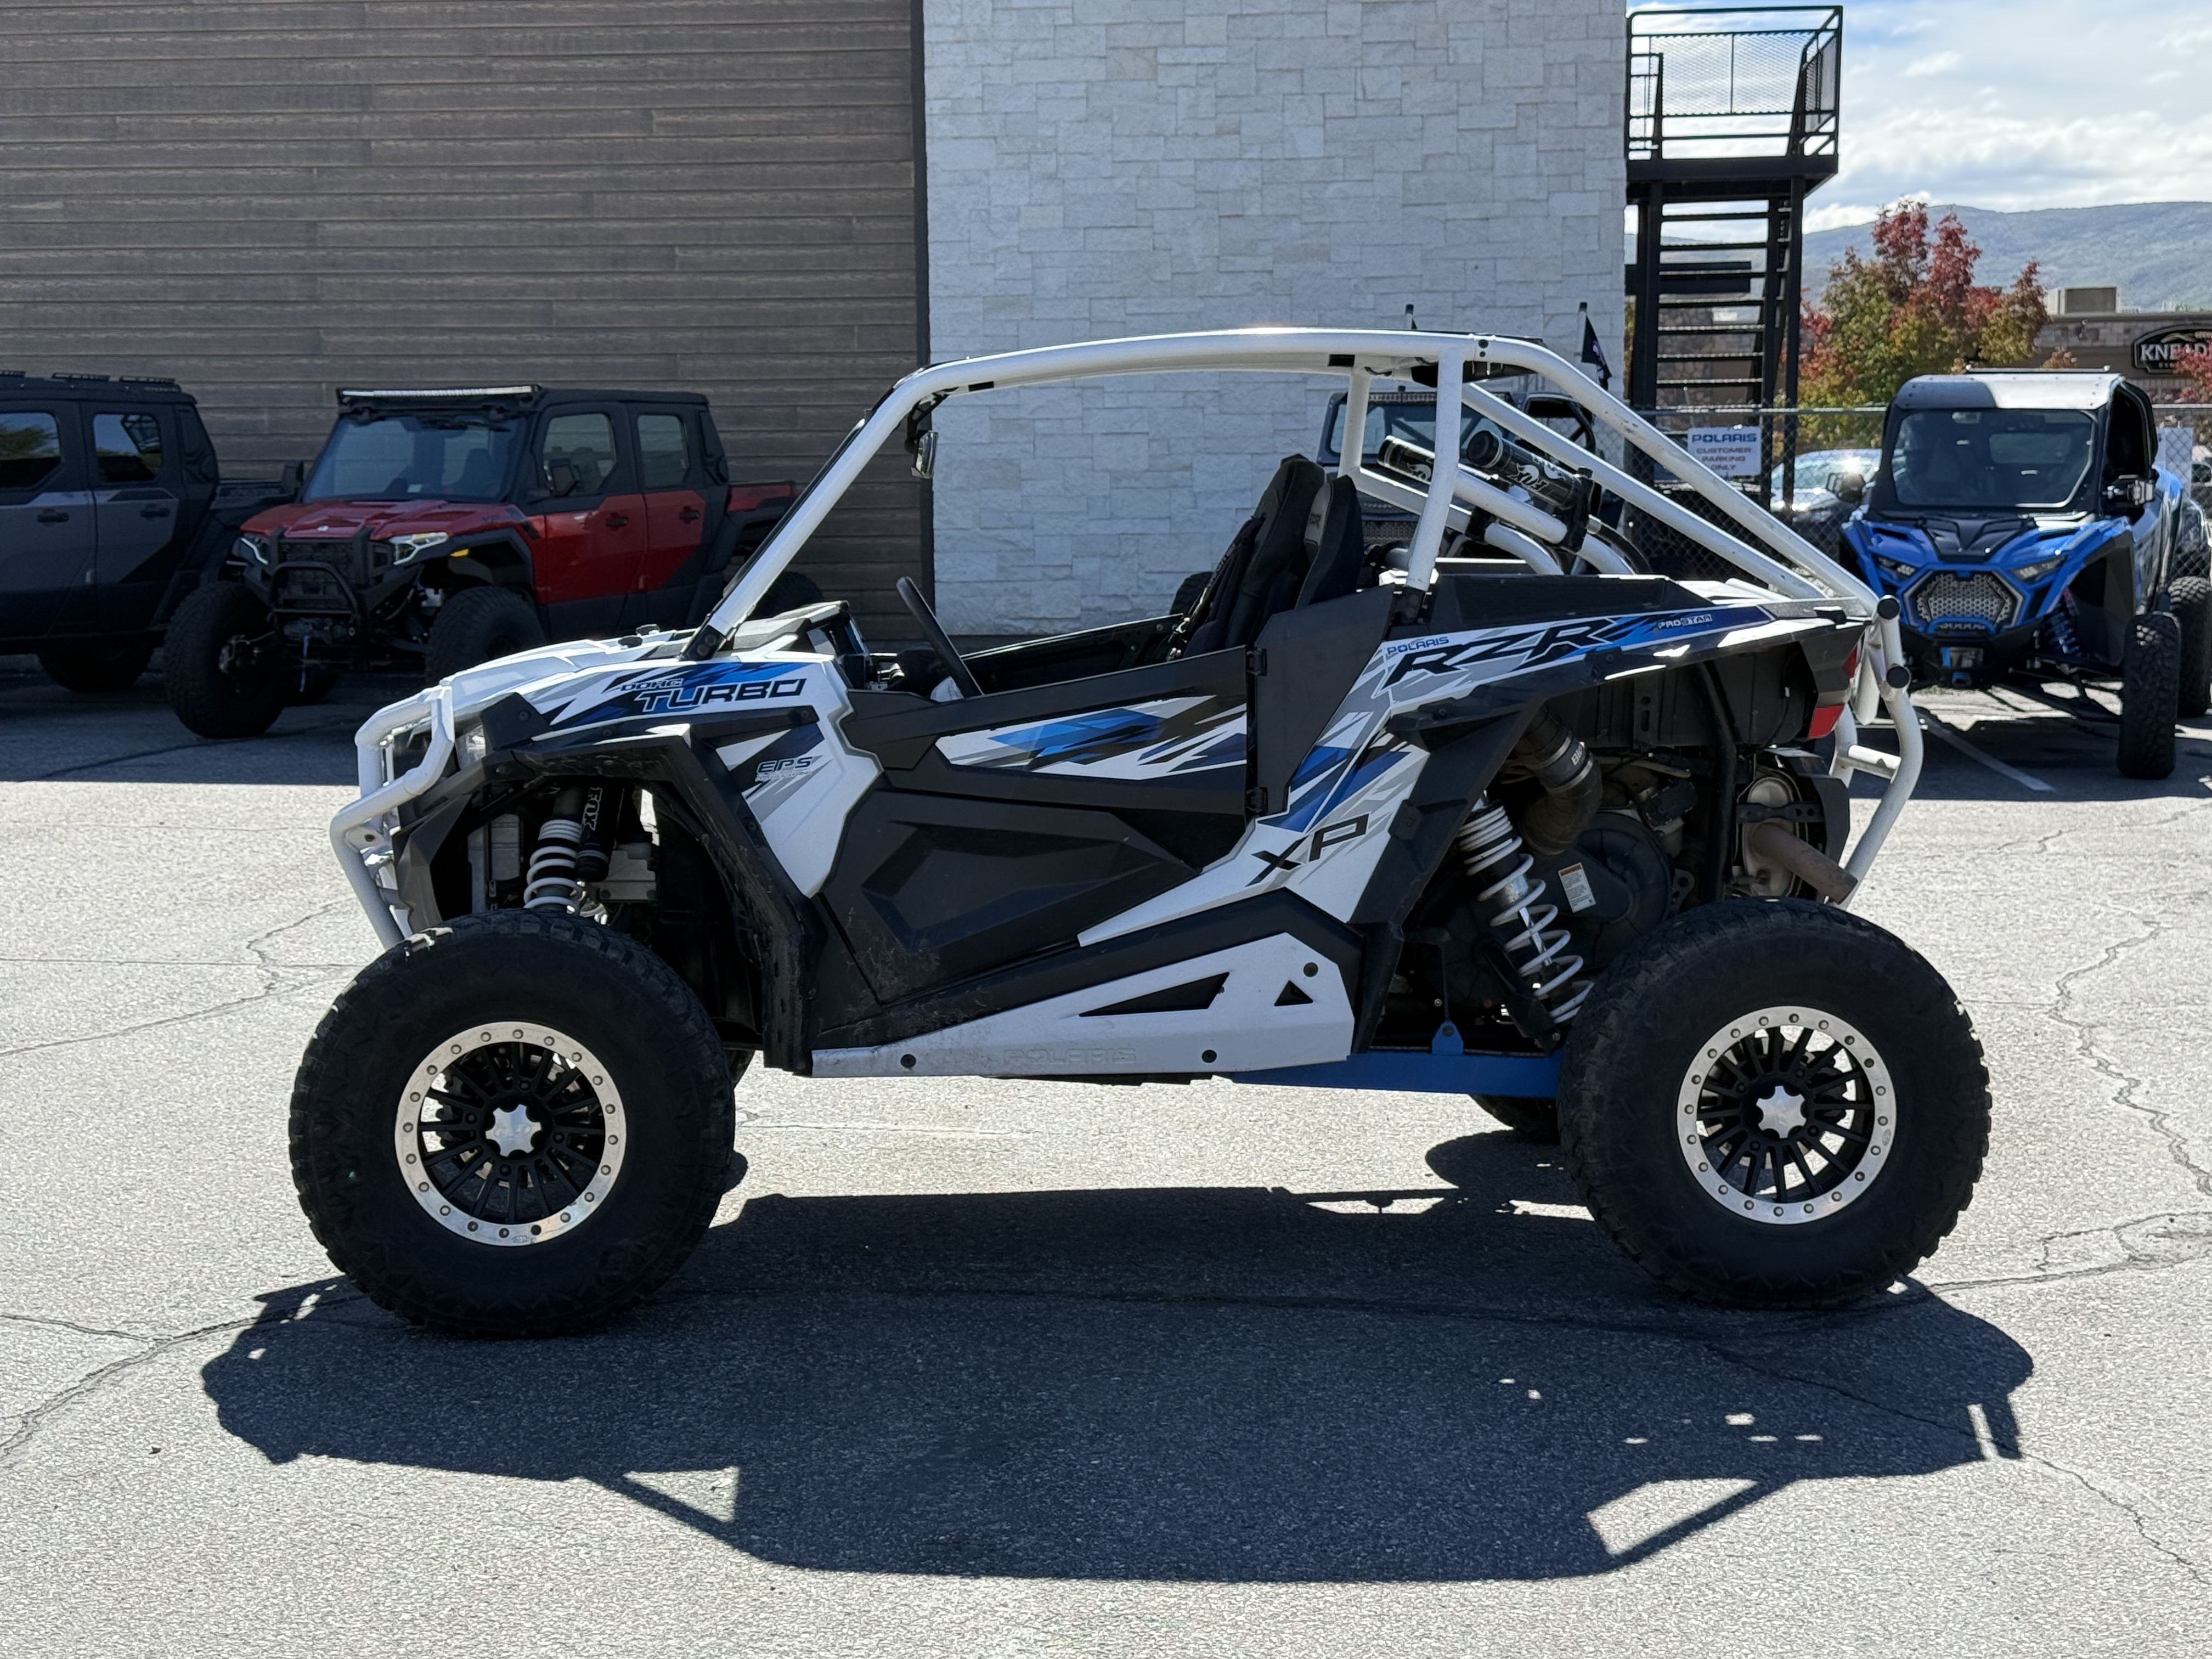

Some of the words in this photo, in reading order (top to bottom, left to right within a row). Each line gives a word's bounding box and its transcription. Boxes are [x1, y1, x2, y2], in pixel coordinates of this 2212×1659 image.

[1692, 433, 1757, 443] POLARIS
[1506, 467, 1549, 492] FOX
[1658, 614, 1712, 629] PROSTAR
[1386, 636, 1449, 656] POLARIS
[1375, 618, 1616, 695] RZR
[620, 678, 684, 691] DOHC
[634, 678, 807, 713] TURBO
[757, 757, 813, 773] EPS
[582, 787, 603, 831] FOX
[1244, 813, 1370, 888] XP
[1003, 1048, 1136, 1065] POLARIS
